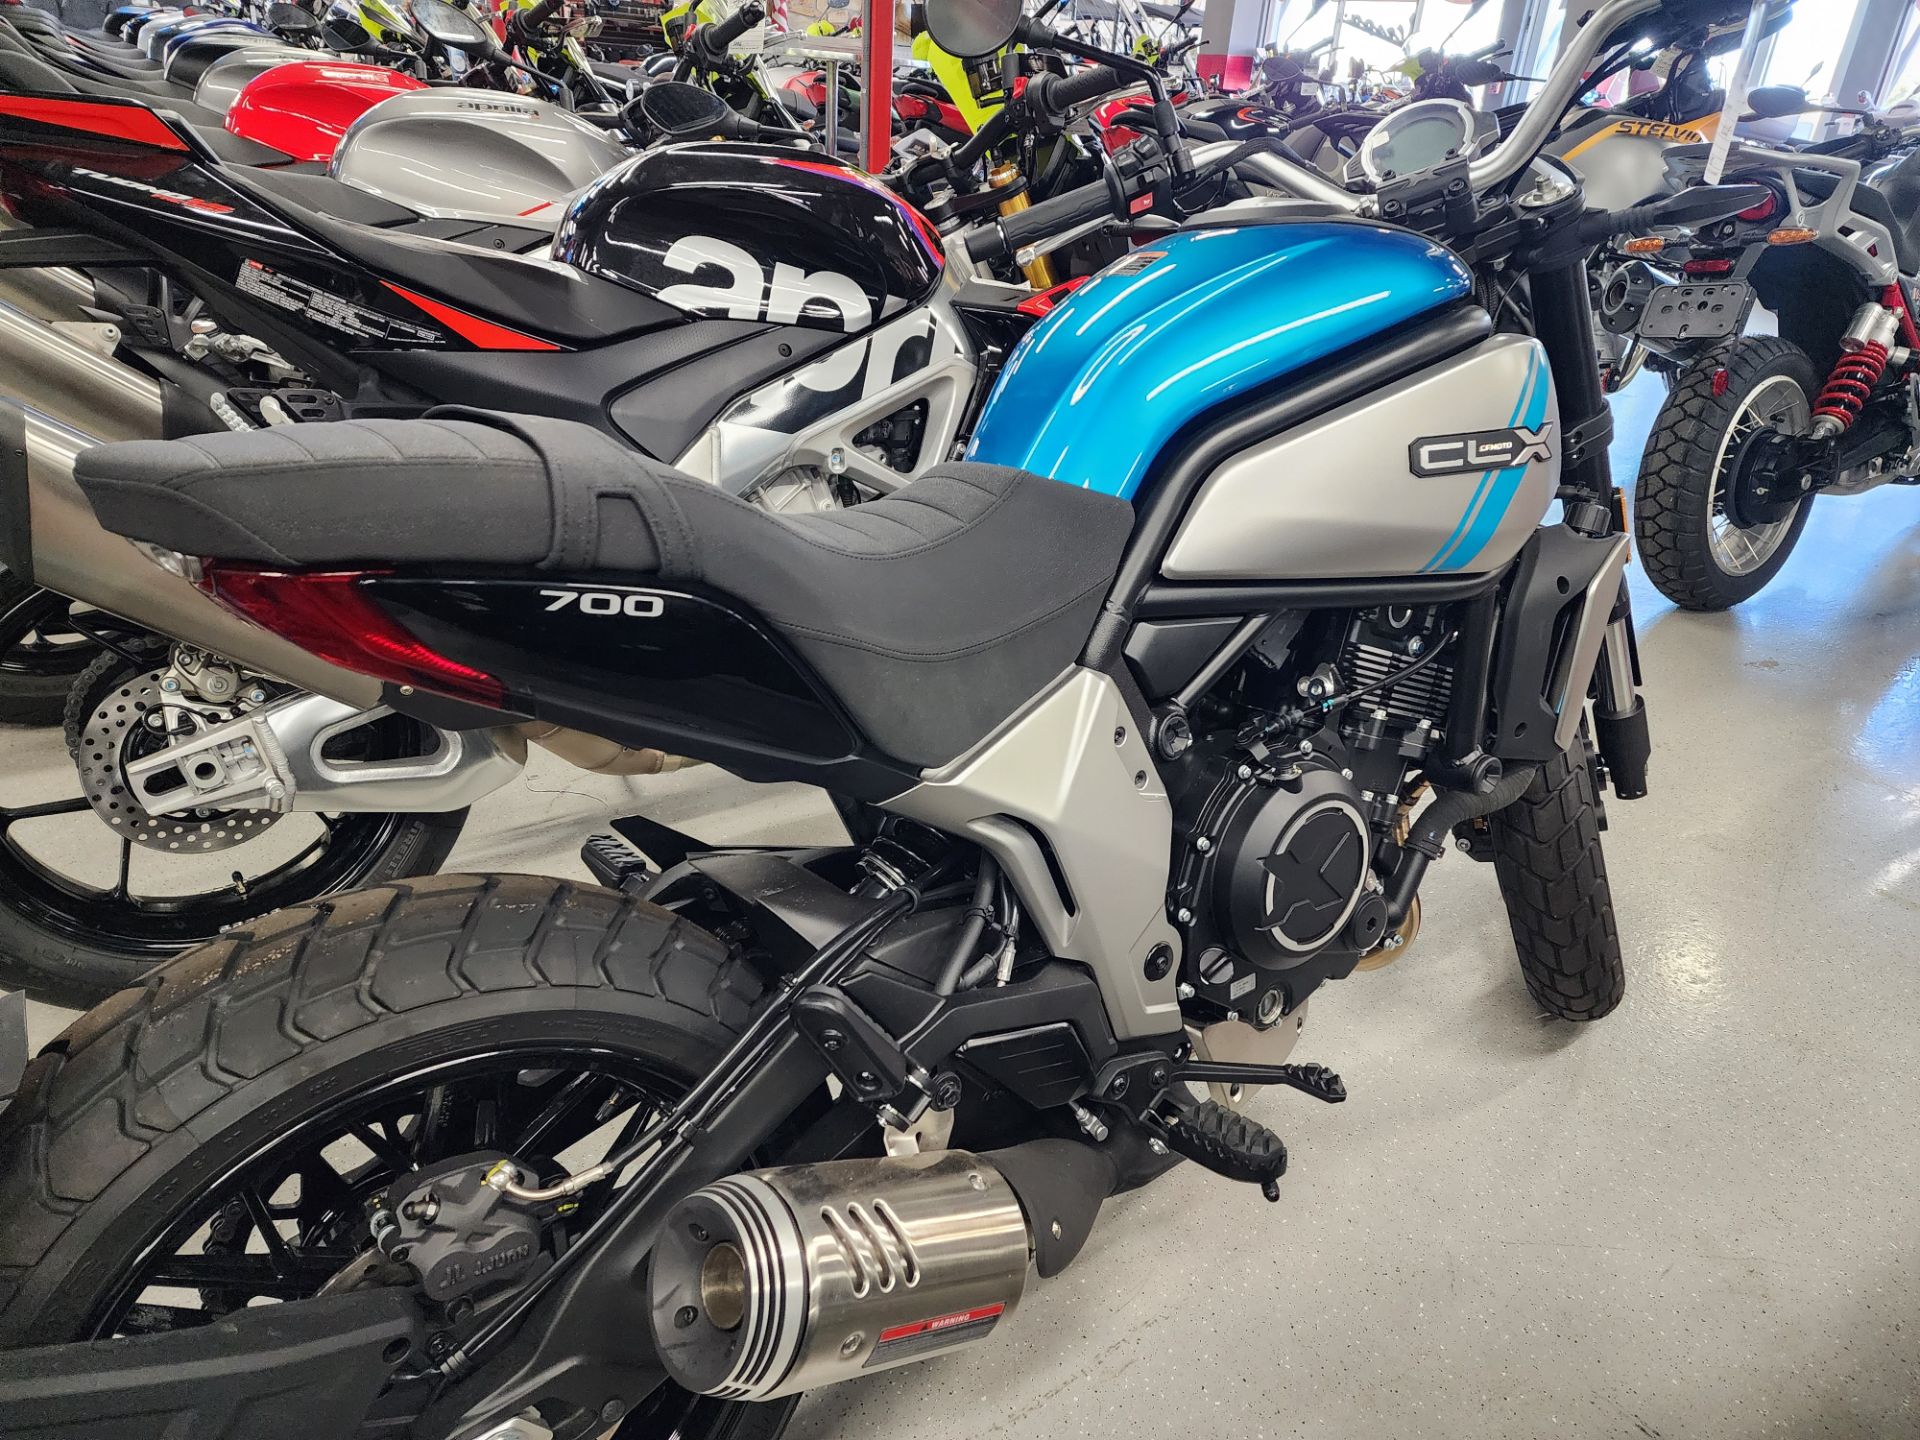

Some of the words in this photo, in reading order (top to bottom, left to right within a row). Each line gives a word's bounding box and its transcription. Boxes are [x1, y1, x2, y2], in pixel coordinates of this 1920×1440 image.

[1419, 423, 1553, 470] CLX
[1479, 441, 1513, 453] CFMOTO
[540, 589, 665, 618] 700
[931, 1313, 971, 1329] WARNING
